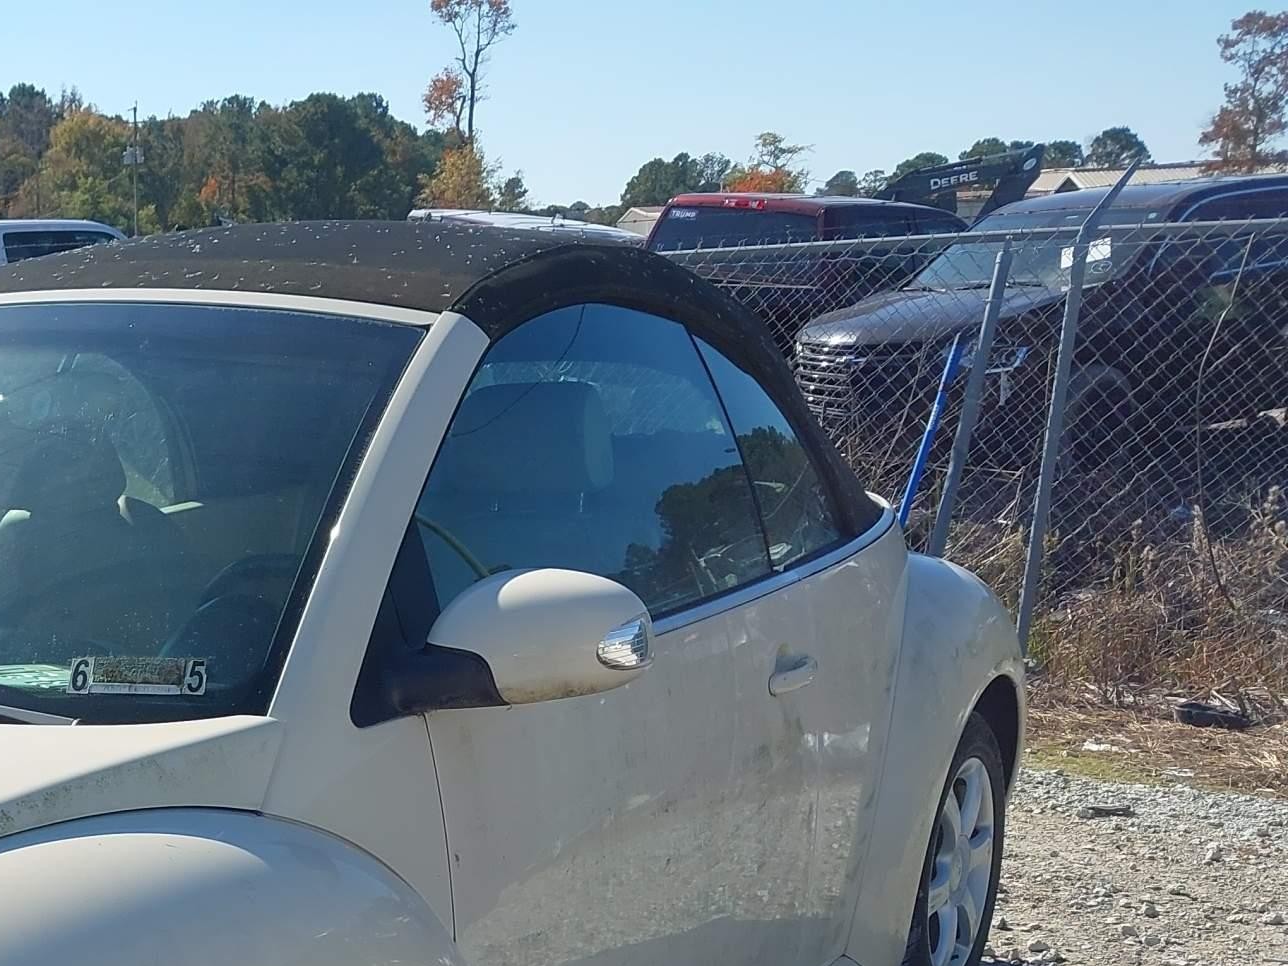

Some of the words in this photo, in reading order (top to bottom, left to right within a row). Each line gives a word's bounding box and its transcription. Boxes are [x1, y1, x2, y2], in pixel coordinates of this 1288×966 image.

[929, 170, 978, 190] DEERE
[71, 659, 90, 692] 6
[186, 660, 206, 693] 5
